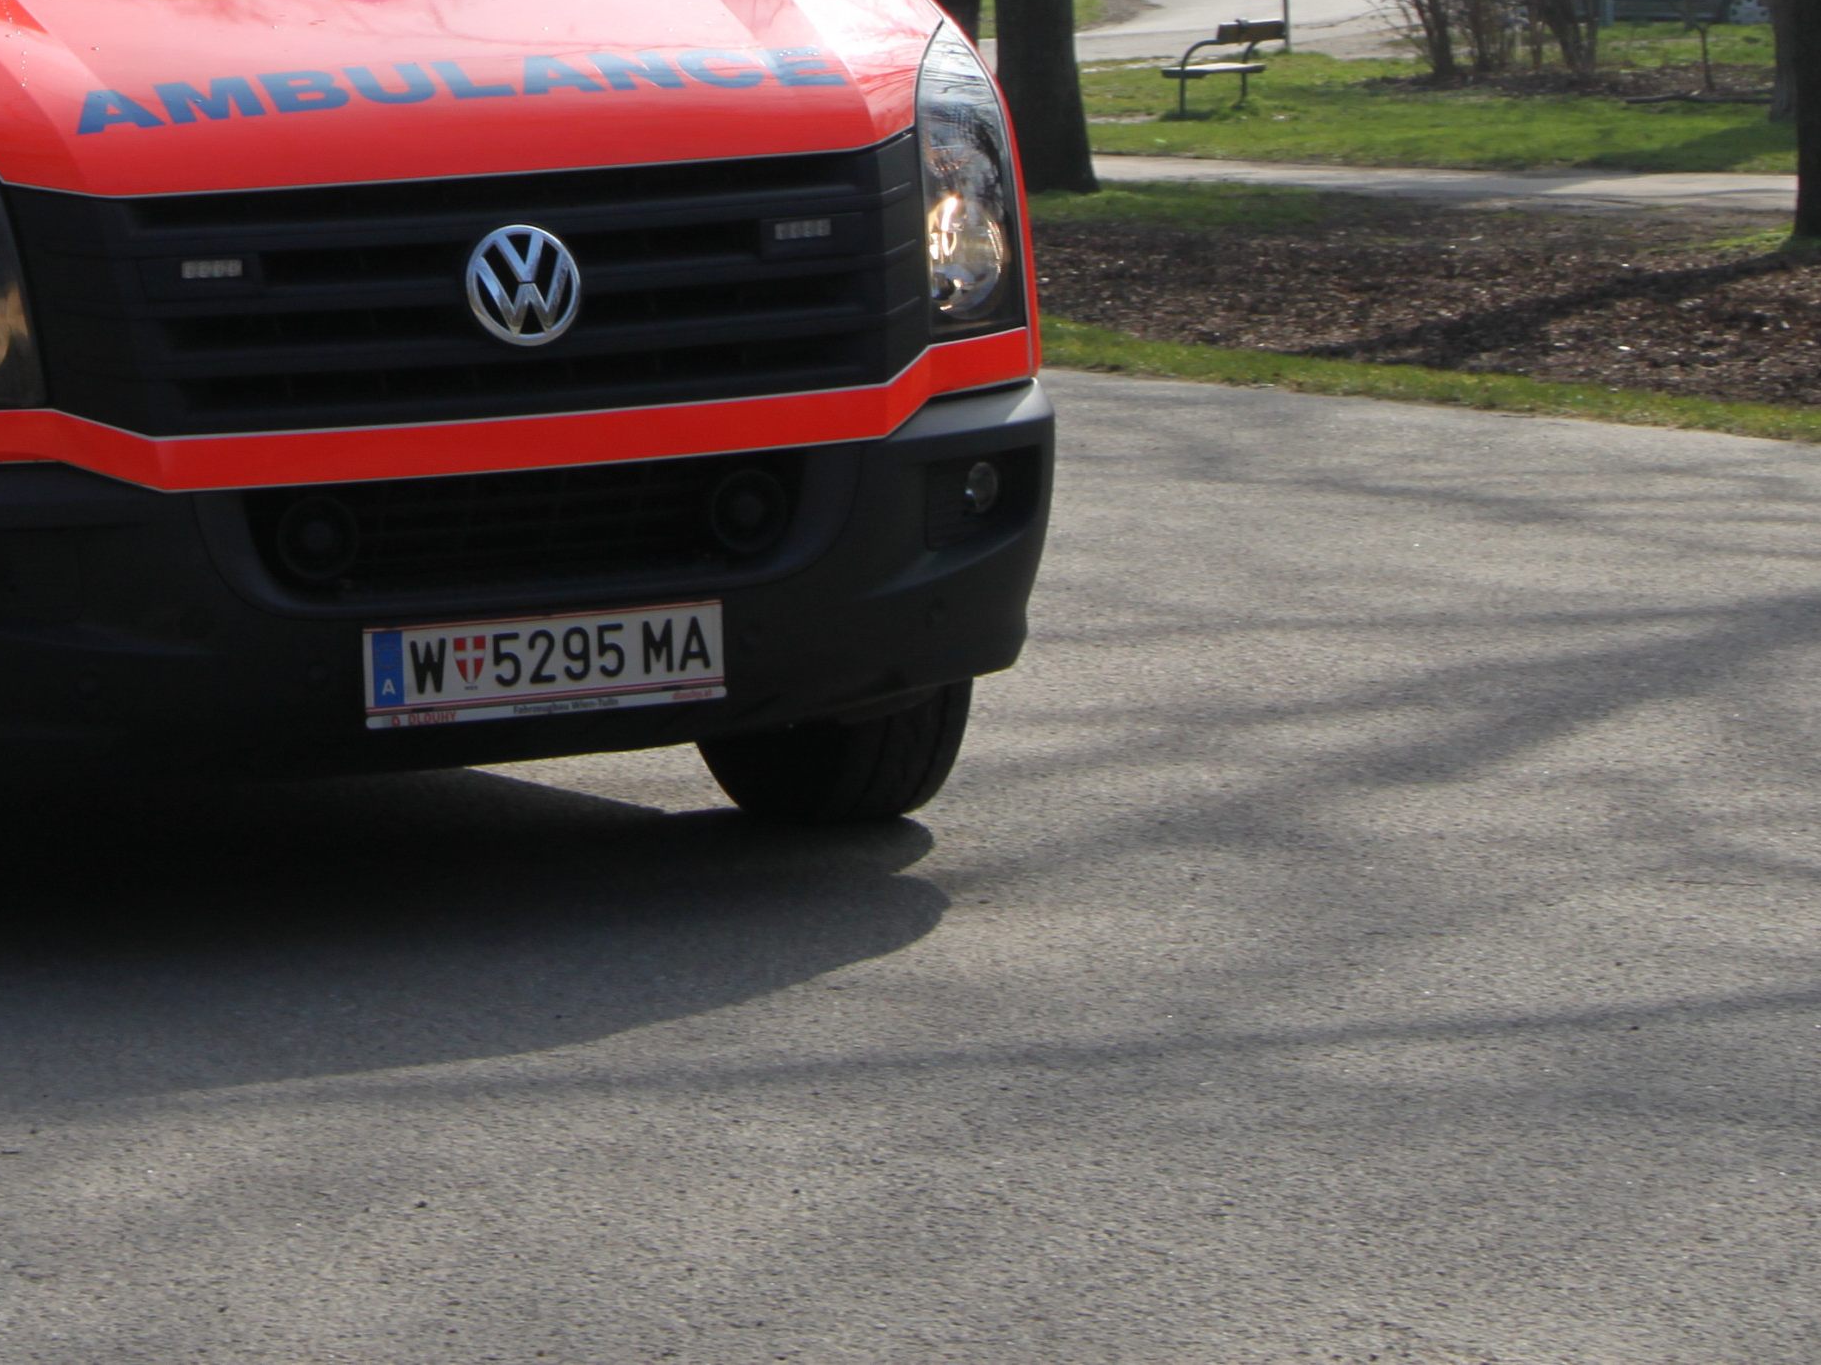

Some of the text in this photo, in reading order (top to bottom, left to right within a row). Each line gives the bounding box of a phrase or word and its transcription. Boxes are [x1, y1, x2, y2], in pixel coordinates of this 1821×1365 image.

[77, 46, 849, 135] AMBULANCE
[382, 679, 396, 695] A
[410, 616, 711, 694] W 5295 MA
